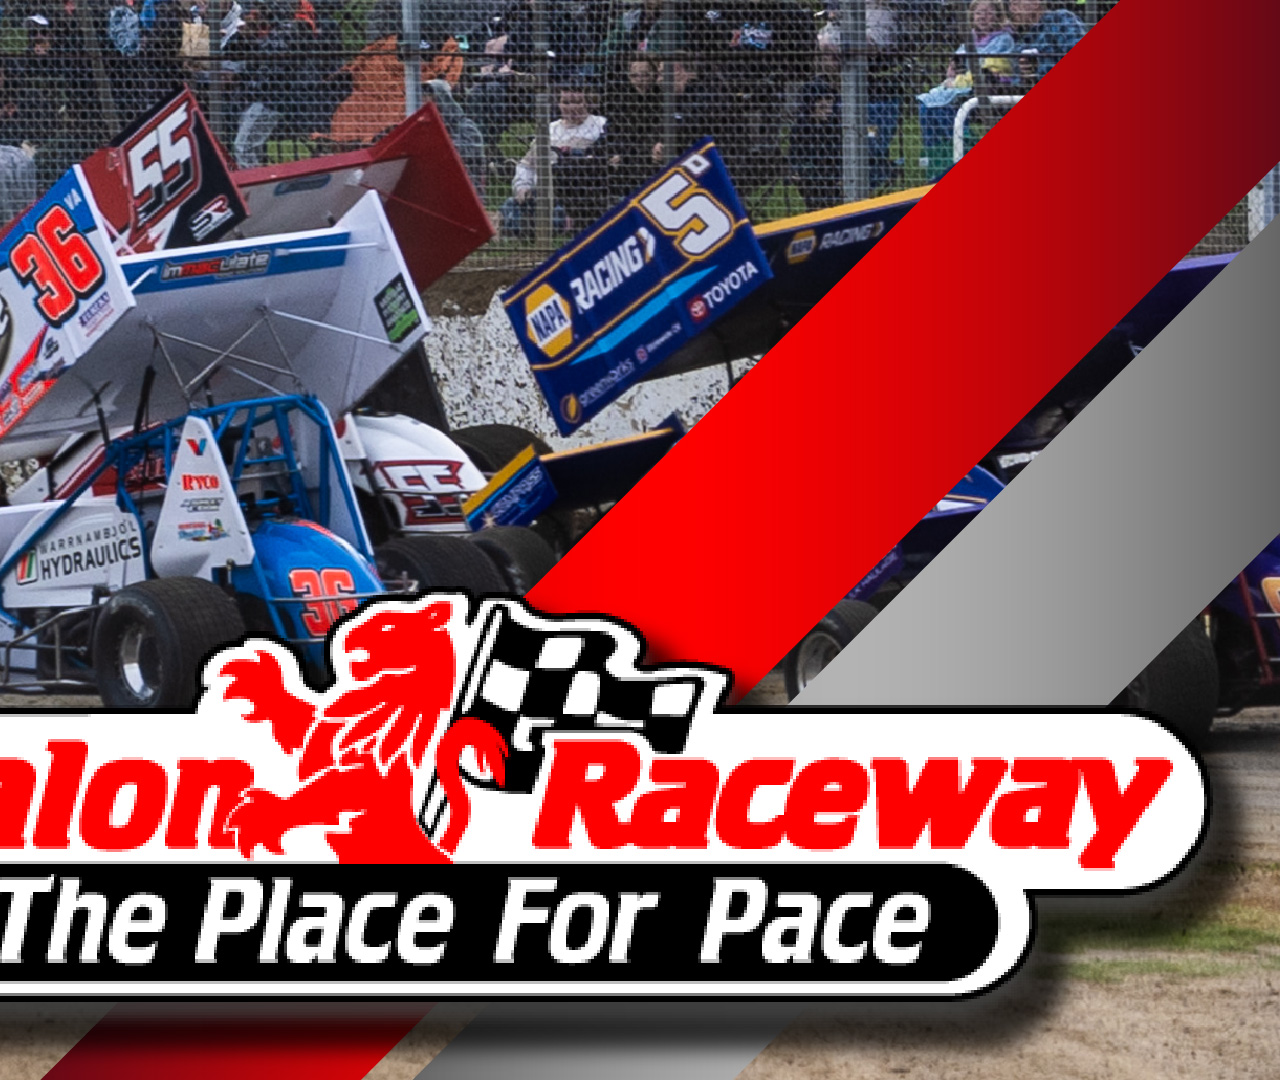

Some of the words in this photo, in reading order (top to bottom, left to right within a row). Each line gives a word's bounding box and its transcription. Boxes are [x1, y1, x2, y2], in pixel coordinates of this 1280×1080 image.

[637, 166, 737, 261] 5
[8, 204, 105, 330] 36
[527, 294, 572, 349] NAPA
[569, 233, 643, 315] RACING
[703, 260, 759, 309] TOYOTA
[181, 474, 220, 491] RYCO
[41, 537, 142, 581] HYDRAULICS
